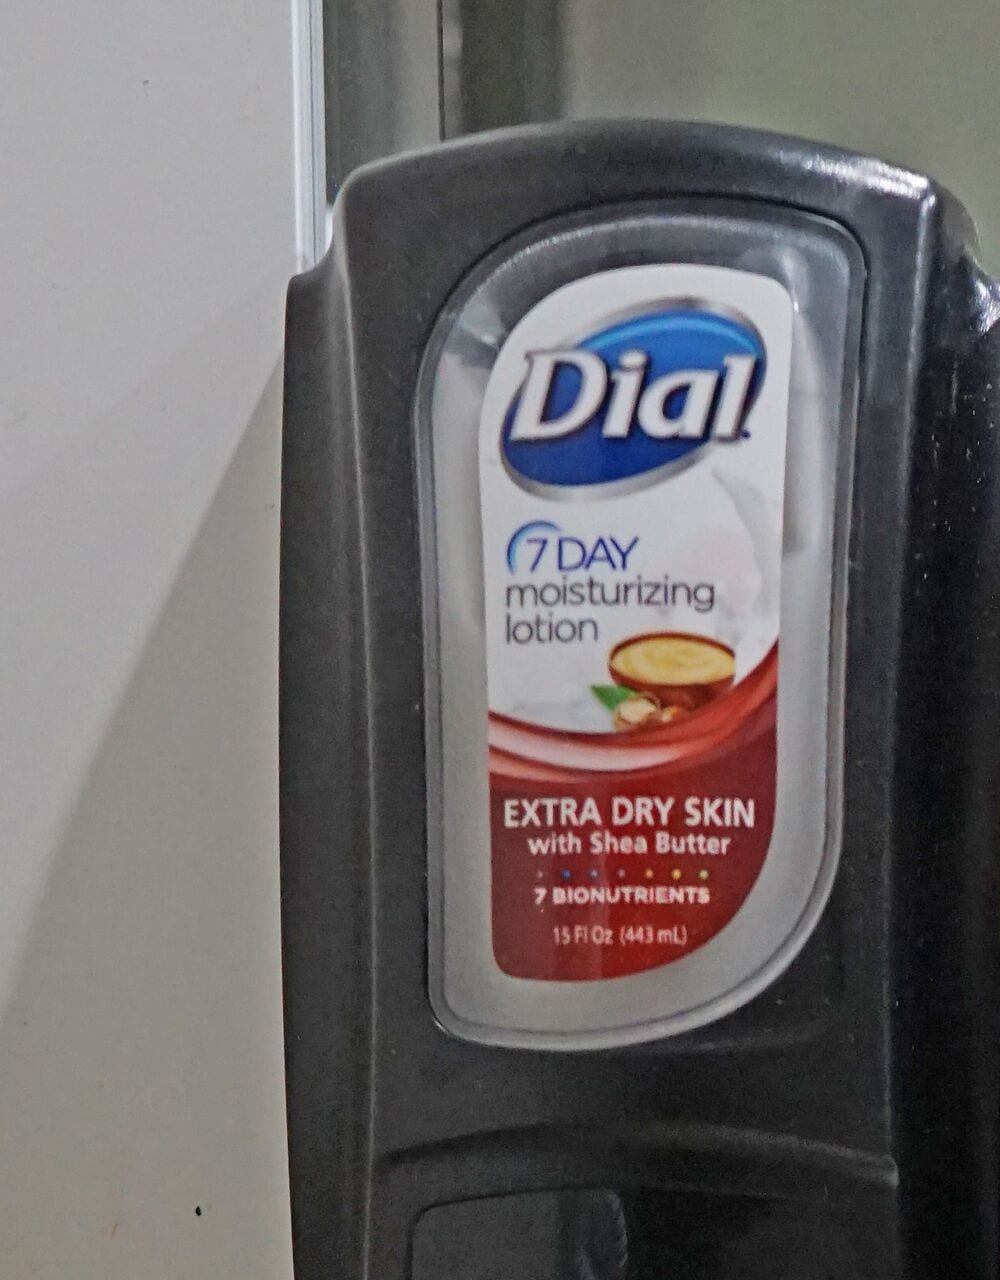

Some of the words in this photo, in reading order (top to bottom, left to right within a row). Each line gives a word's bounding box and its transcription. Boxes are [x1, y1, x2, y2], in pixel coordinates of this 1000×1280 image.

[509, 347, 757, 442] Dial
[557, 536, 639, 571] DAY
[506, 574, 715, 611] moisturizing
[506, 613, 598, 644] lotion
[504, 799, 601, 829] EXTRA
[611, 798, 675, 827] DRY
[685, 798, 755, 828] SKIN
[528, 832, 581, 855] with
[589, 832, 648, 855] Shea
[655, 832, 731, 855] Butter
[533, 888, 546, 905] 7
[552, 887, 710, 904] BIONUTRIENTS
[553, 926, 571, 945] 15
[592, 926, 613, 945] Oz
[619, 924, 654, 946] (443
[657, 924, 688, 946] mL)
